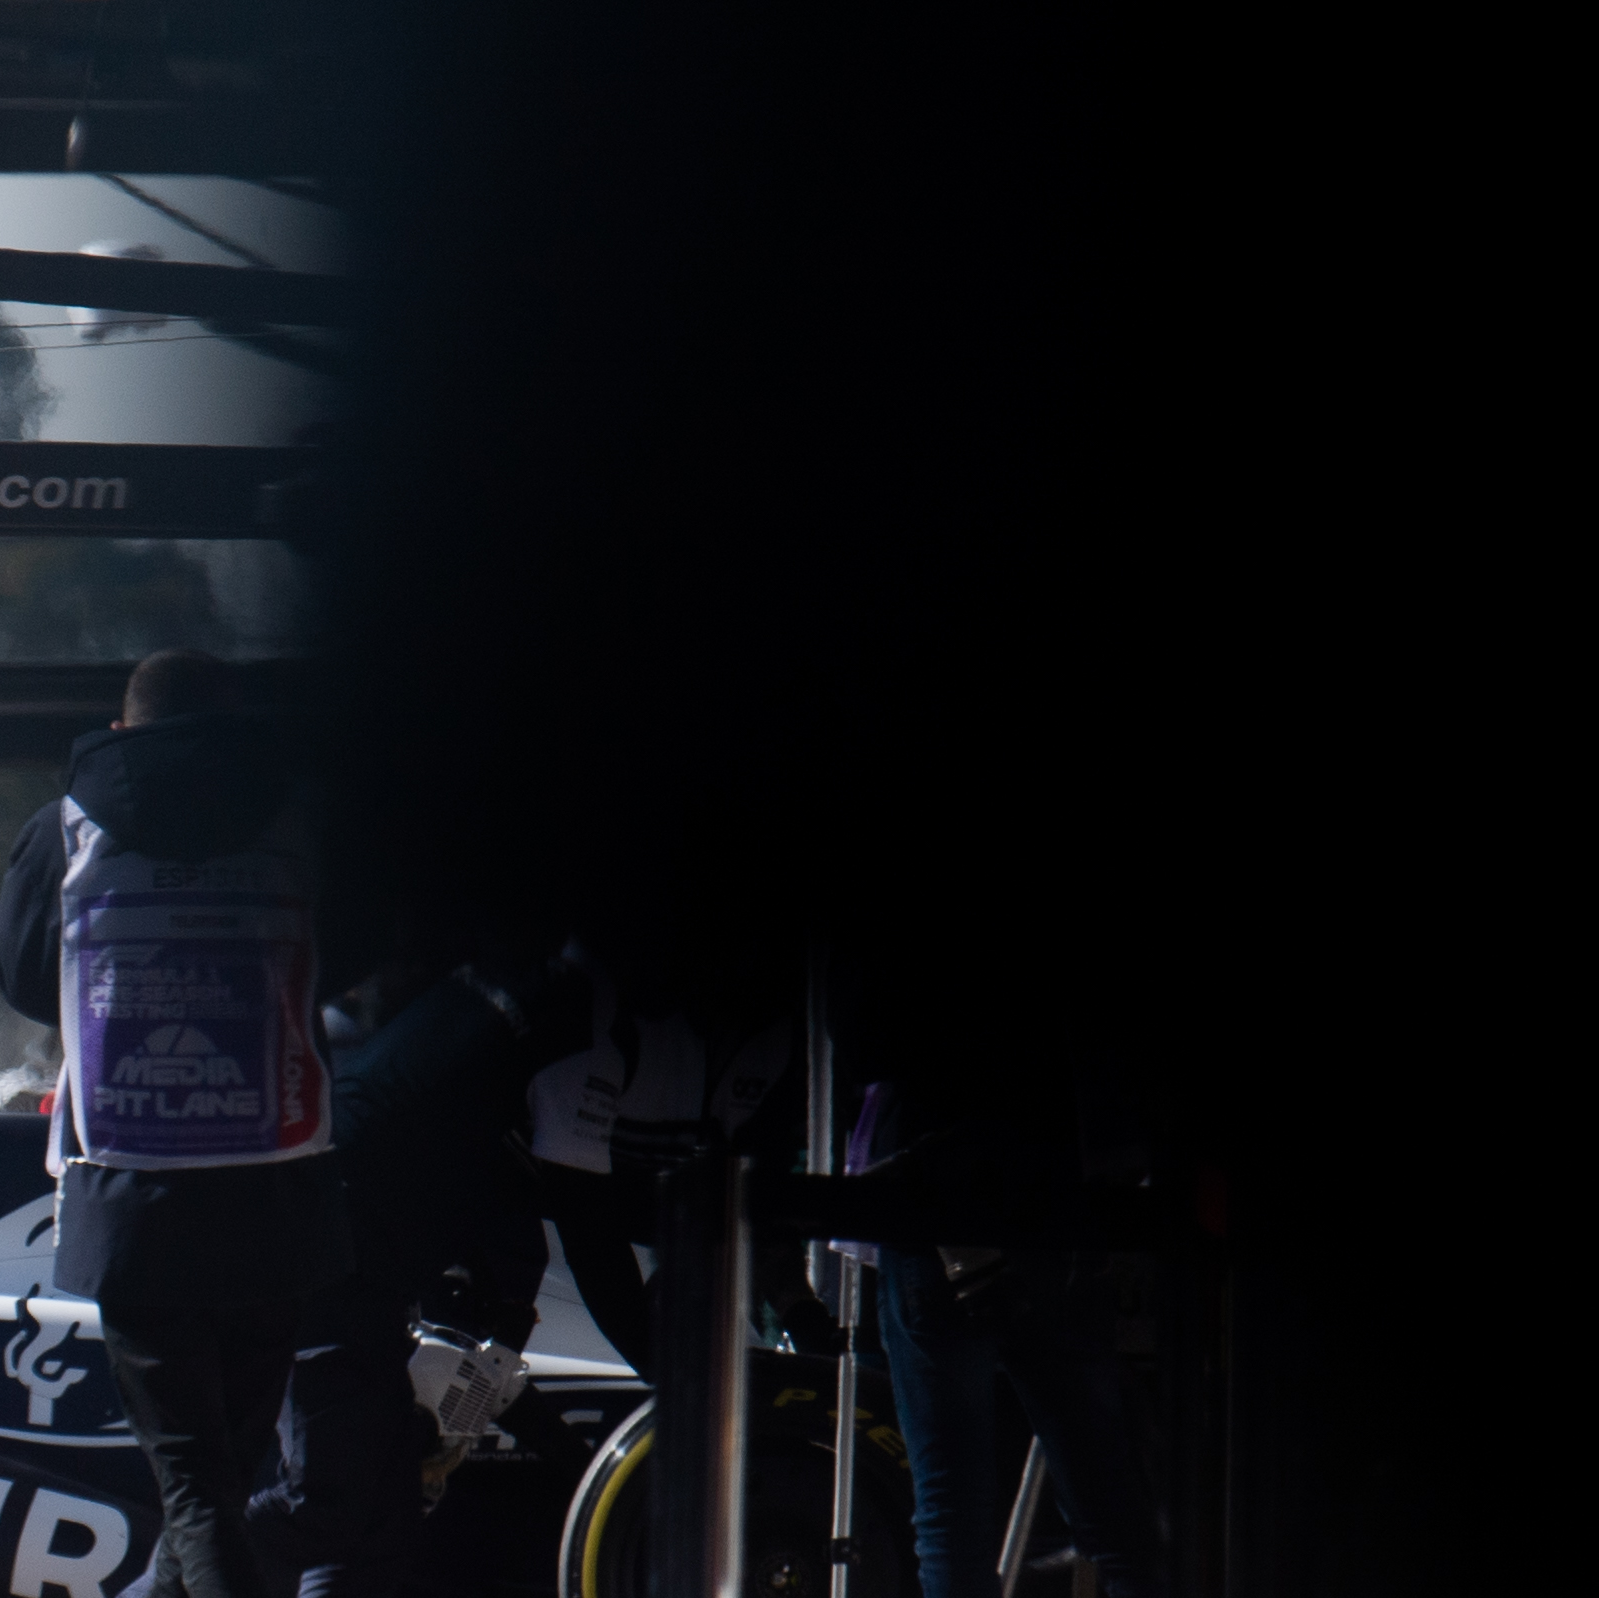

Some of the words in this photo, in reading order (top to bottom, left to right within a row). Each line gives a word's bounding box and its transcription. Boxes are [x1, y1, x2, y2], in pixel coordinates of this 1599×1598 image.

[110, 1054, 247, 1087] MEDIA
[92, 1085, 152, 1118] PIT
[155, 1089, 261, 1119] LANE
